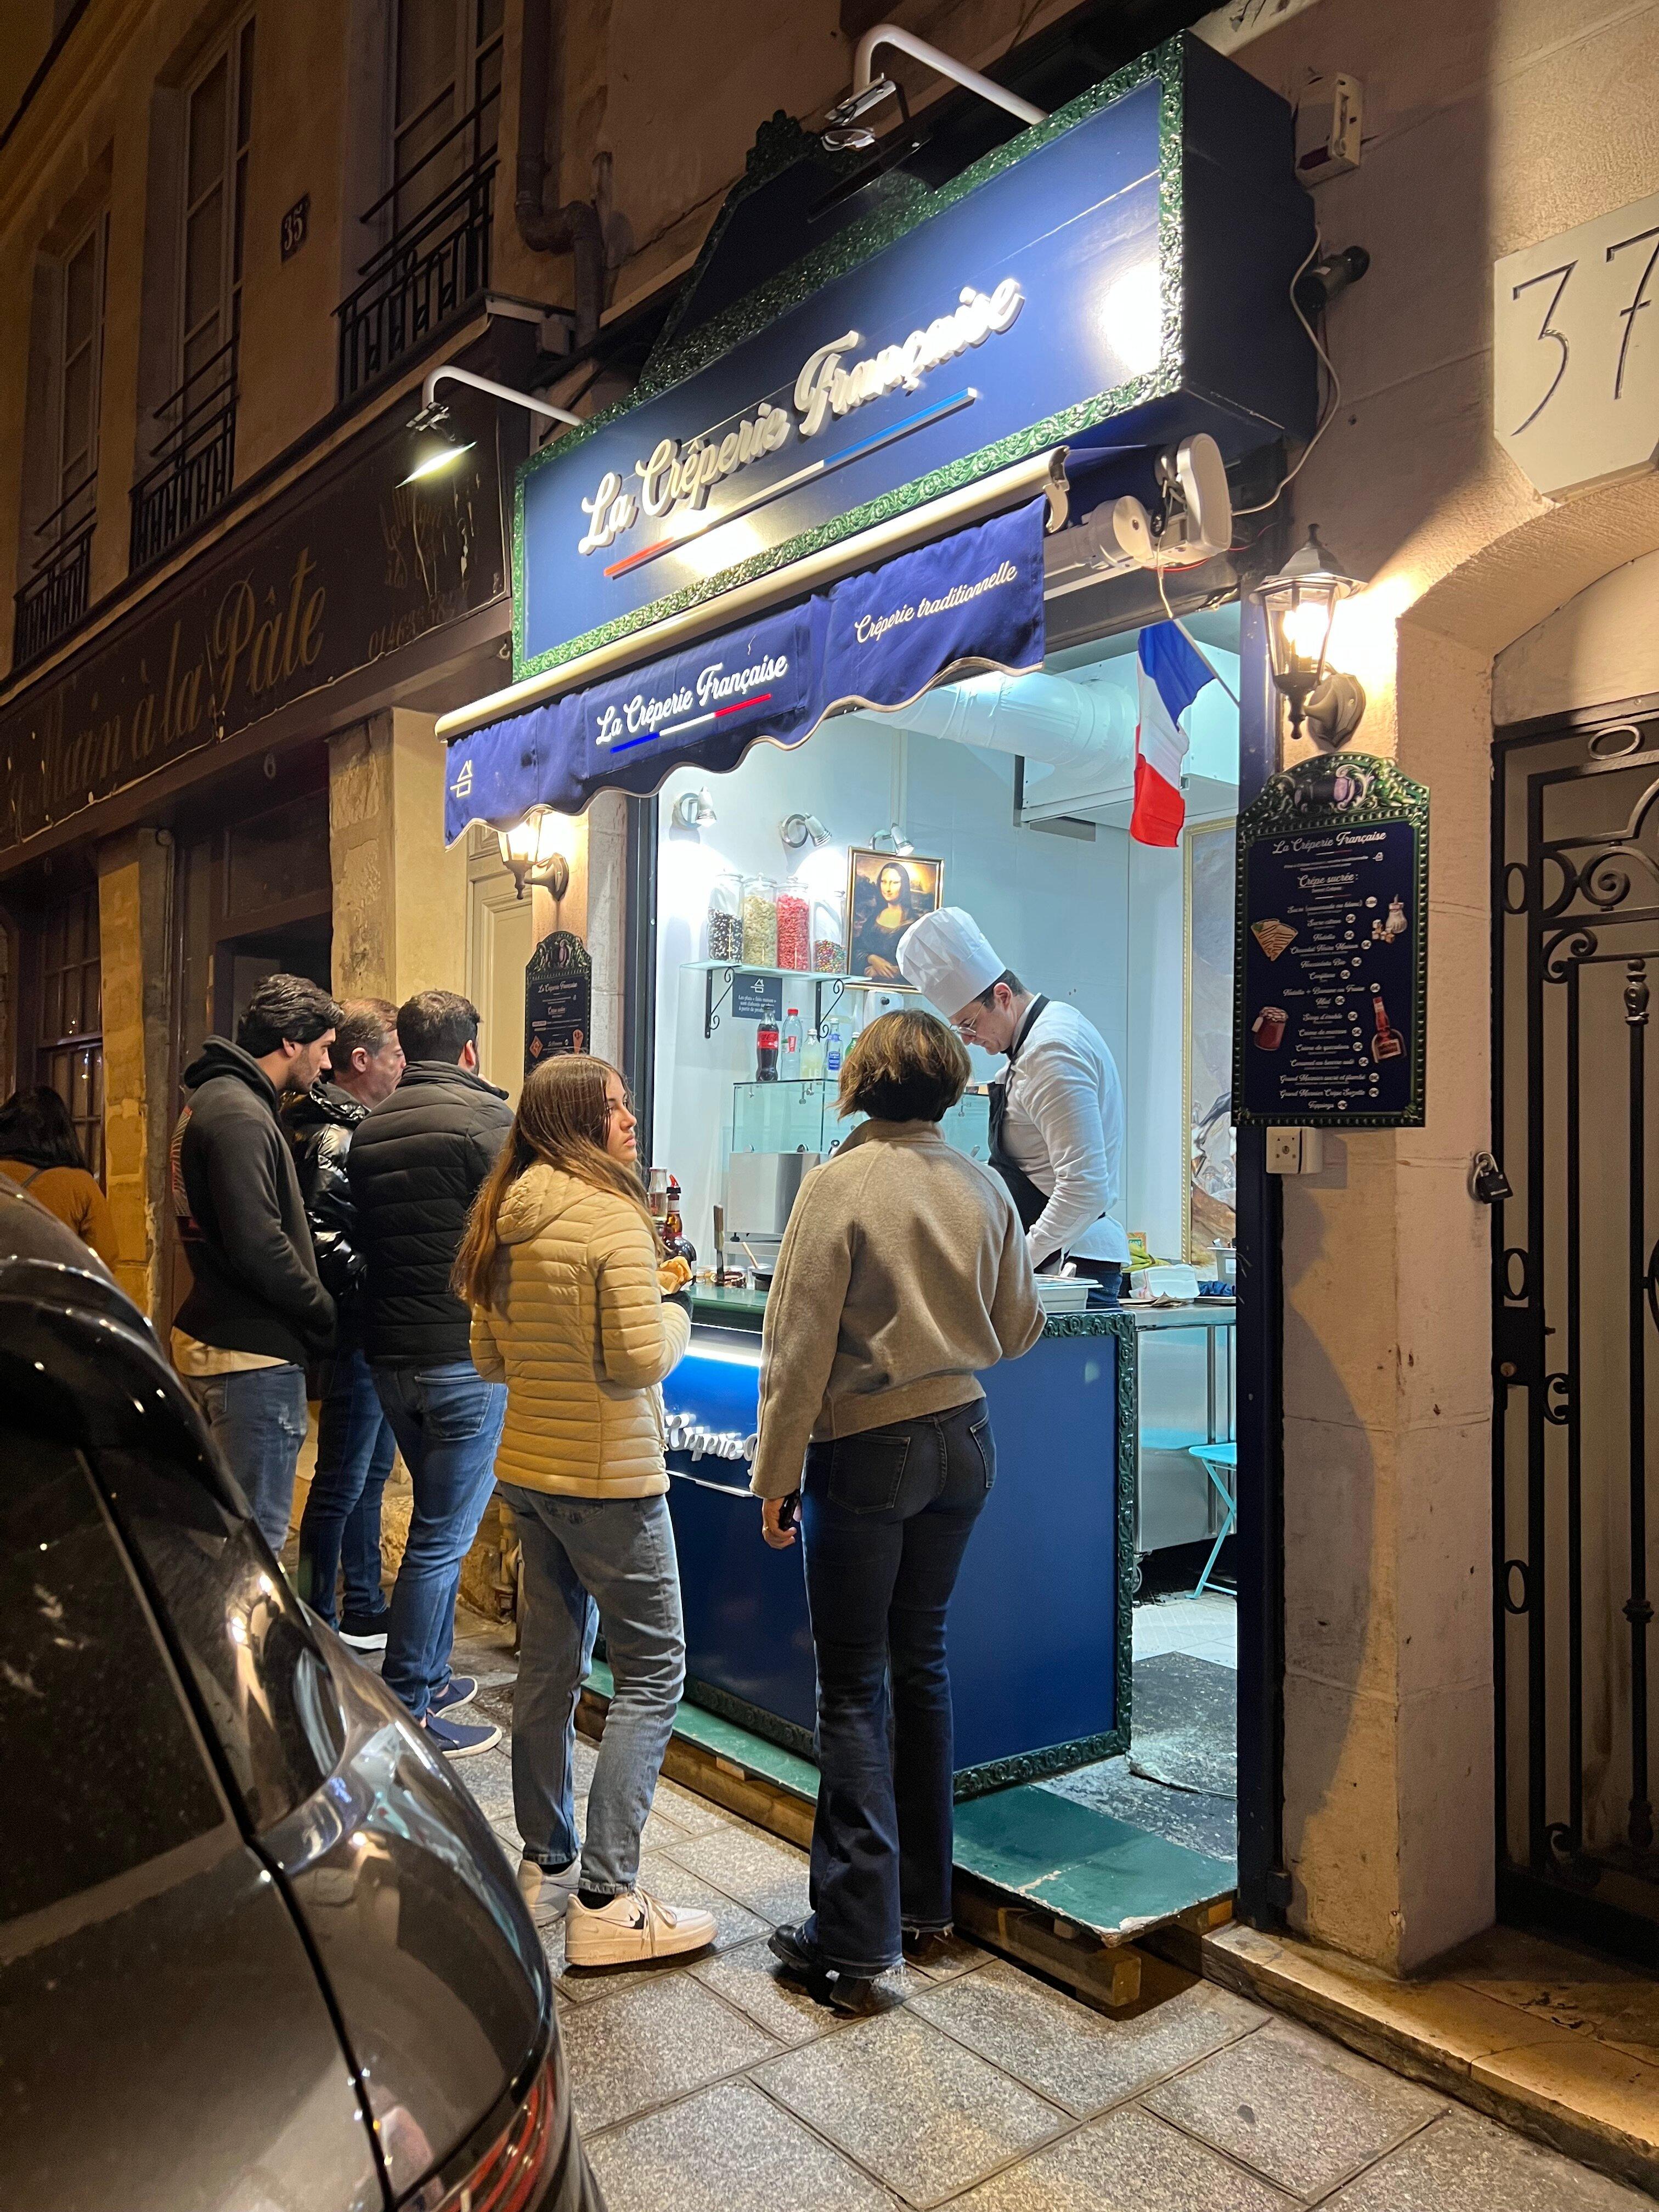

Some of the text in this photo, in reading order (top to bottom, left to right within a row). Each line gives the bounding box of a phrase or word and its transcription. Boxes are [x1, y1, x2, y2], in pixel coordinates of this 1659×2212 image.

[1510, 227, 1659, 437] 37
[578, 470, 638, 556] La
[635, 401, 790, 517] Crêperie
[793, 277, 1025, 437] Française
[208, 546, 327, 718] Pâte
[854, 560, 1018, 643] Crêperie traditionnelle
[595, 654, 788, 745] La Crêperie Française
[1272, 840, 1289, 854] La
[1335, 831, 1387, 847] Française
